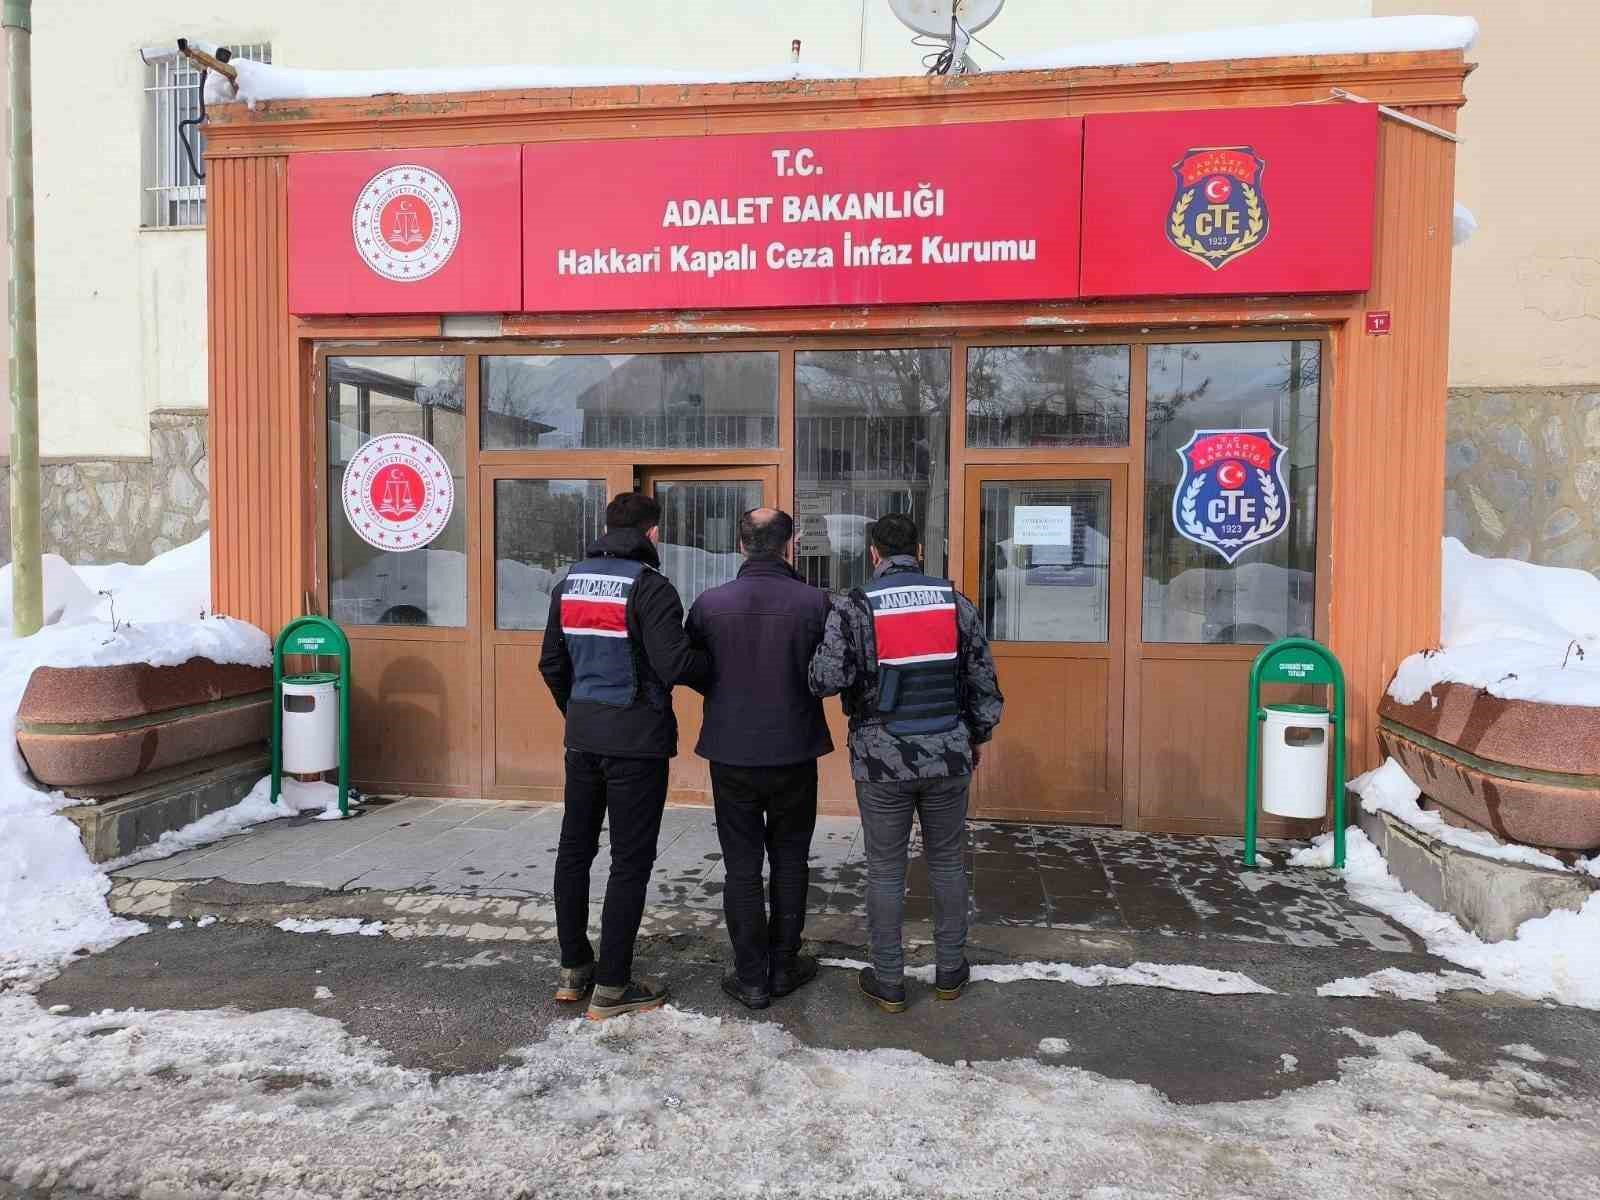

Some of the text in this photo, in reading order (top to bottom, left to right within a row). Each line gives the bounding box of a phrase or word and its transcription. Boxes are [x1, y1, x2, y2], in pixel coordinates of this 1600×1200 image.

[771, 148, 823, 177] T.C.
[662, 183, 944, 227] ADALET BAKANLIĞI
[1195, 204, 1240, 236] CTE
[558, 232, 1036, 277] Hakkari Kapalı Ceza İnfaz Kurumu
[1208, 237, 1228, 245] 1923
[1207, 490, 1256, 523] CTE
[1222, 525, 1242, 533] 1923
[568, 578, 623, 598] JANDARMA
[880, 590, 946, 609] JANDARMA
